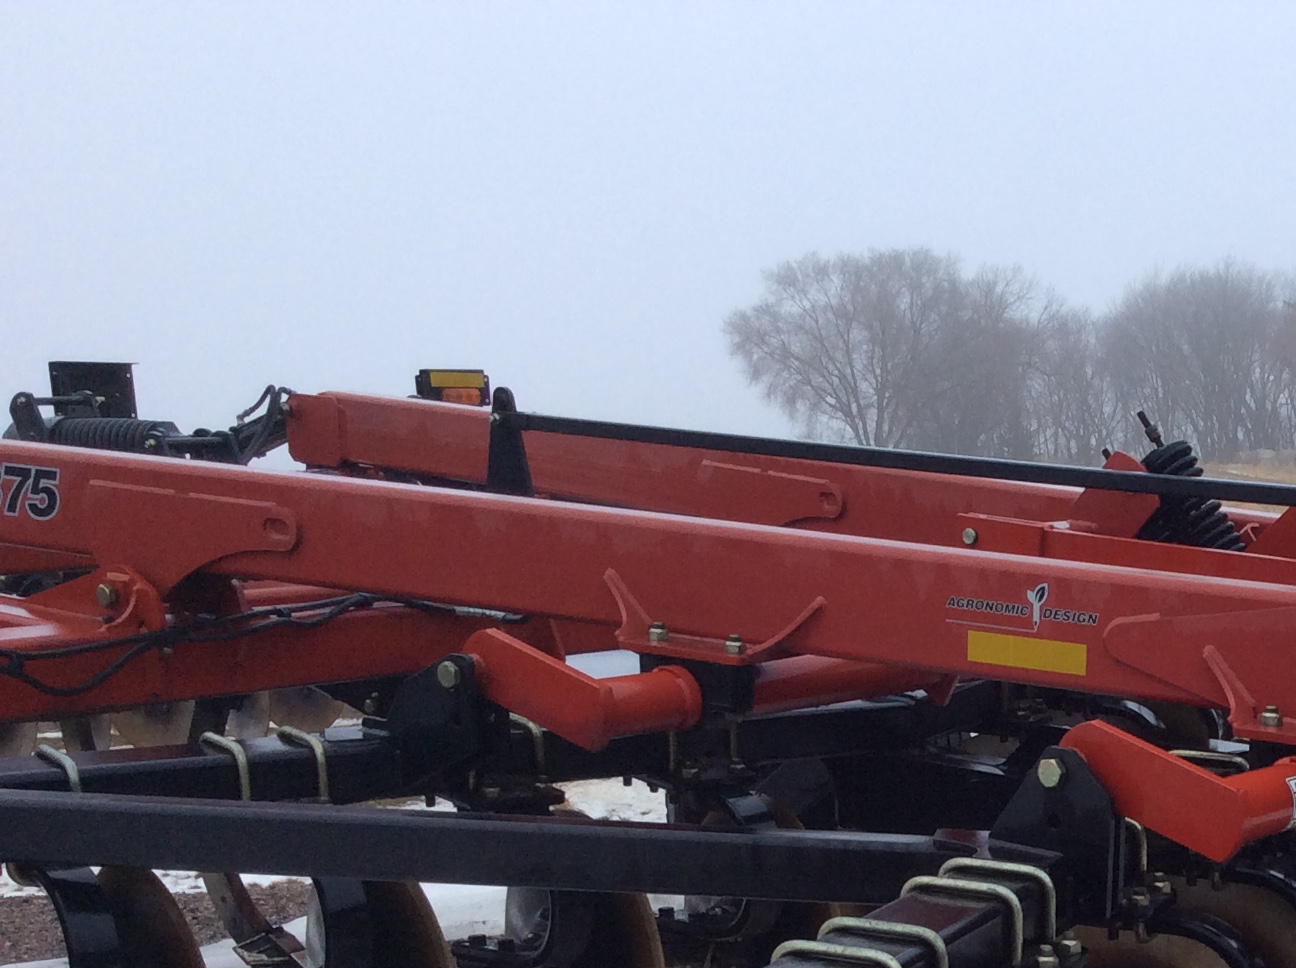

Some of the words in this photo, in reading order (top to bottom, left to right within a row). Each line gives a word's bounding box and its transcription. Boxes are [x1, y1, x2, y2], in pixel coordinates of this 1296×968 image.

[0, 462, 60, 521] 75
[946, 596, 1030, 616] AGRONOMIC
[1042, 608, 1099, 626] DESIGN
